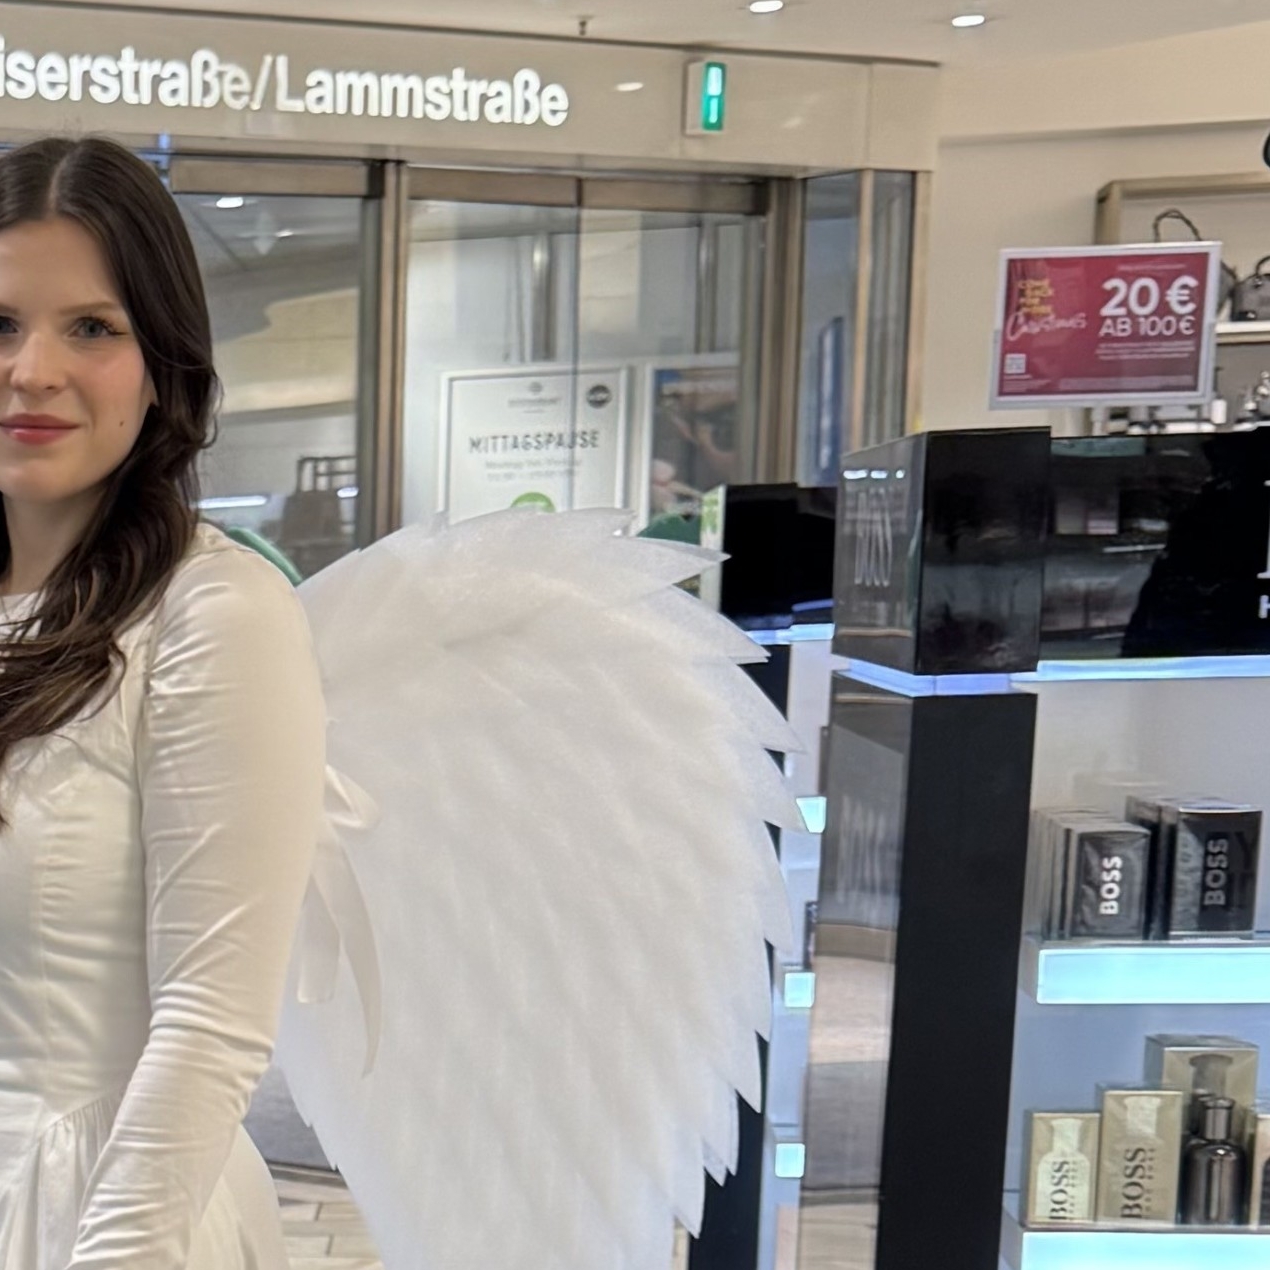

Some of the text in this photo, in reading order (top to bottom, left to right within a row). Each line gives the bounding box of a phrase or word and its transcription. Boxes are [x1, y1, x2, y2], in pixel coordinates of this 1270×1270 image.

[1099, 277, 1160, 317] 20
[1165, 275, 1199, 315] €
[1099, 318, 1132, 337] AB
[1099, 855, 1123, 915] BOSS
[1203, 838, 1229, 906] BOSS
[1049, 1160, 1069, 1220] BOSS
[1121, 1147, 1146, 1219] BOSS
